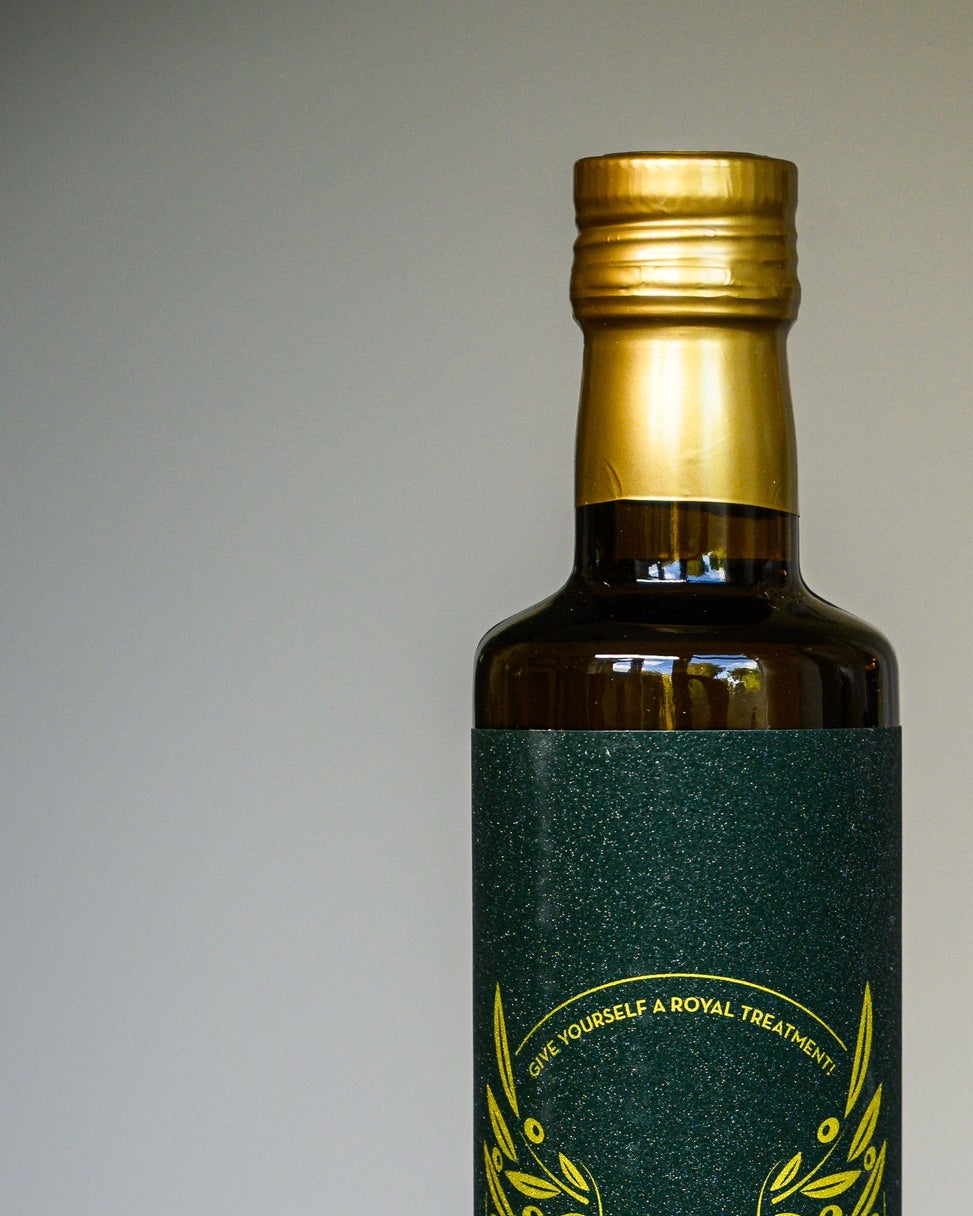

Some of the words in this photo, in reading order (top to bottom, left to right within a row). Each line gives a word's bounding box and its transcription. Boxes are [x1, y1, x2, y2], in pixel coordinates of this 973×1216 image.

[528, 1040, 559, 1078] GIVE
[556, 998, 647, 1046] YOURSELF
[652, 998, 667, 1014] A
[670, 996, 735, 1018] ROYAL
[741, 1004, 836, 1076] TREATMENT!
